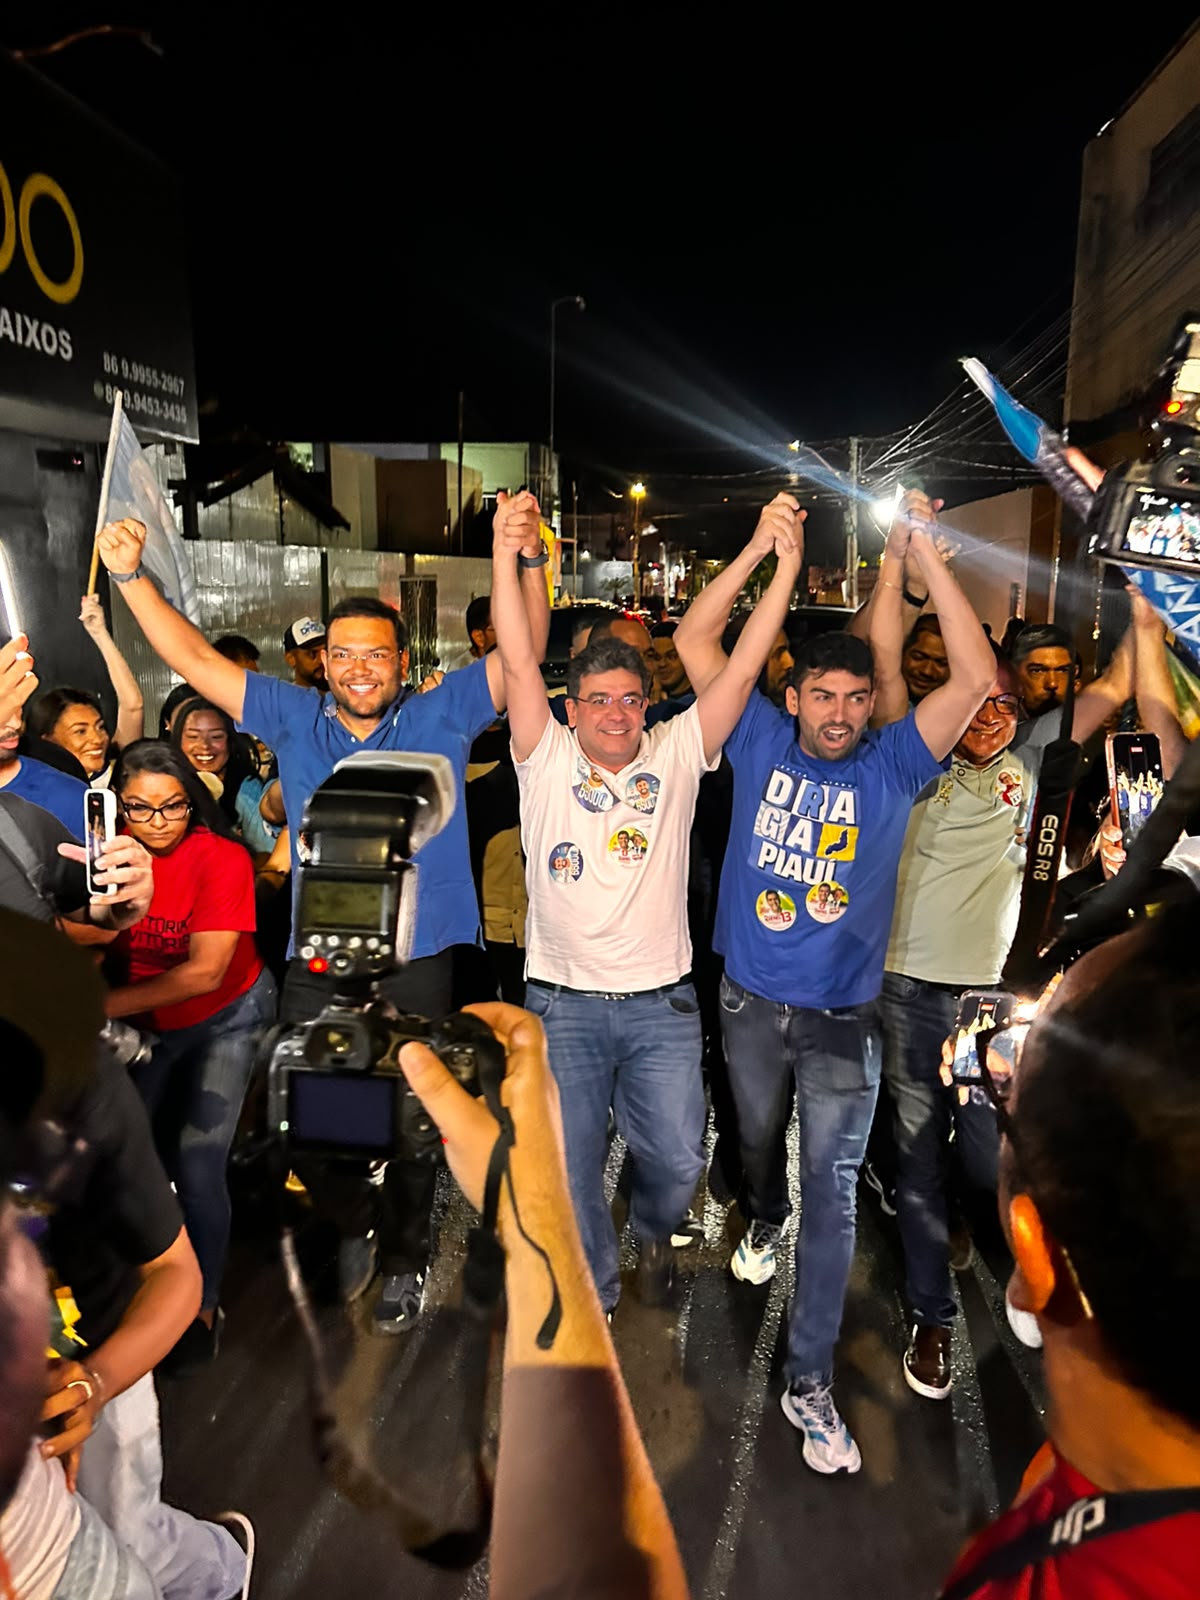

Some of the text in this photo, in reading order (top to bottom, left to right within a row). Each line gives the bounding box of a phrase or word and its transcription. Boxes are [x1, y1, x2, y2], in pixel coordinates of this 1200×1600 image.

[0, 161, 84, 304] O
[103, 351, 119, 375] 86
[1033, 814, 1059, 881] EOS R8
